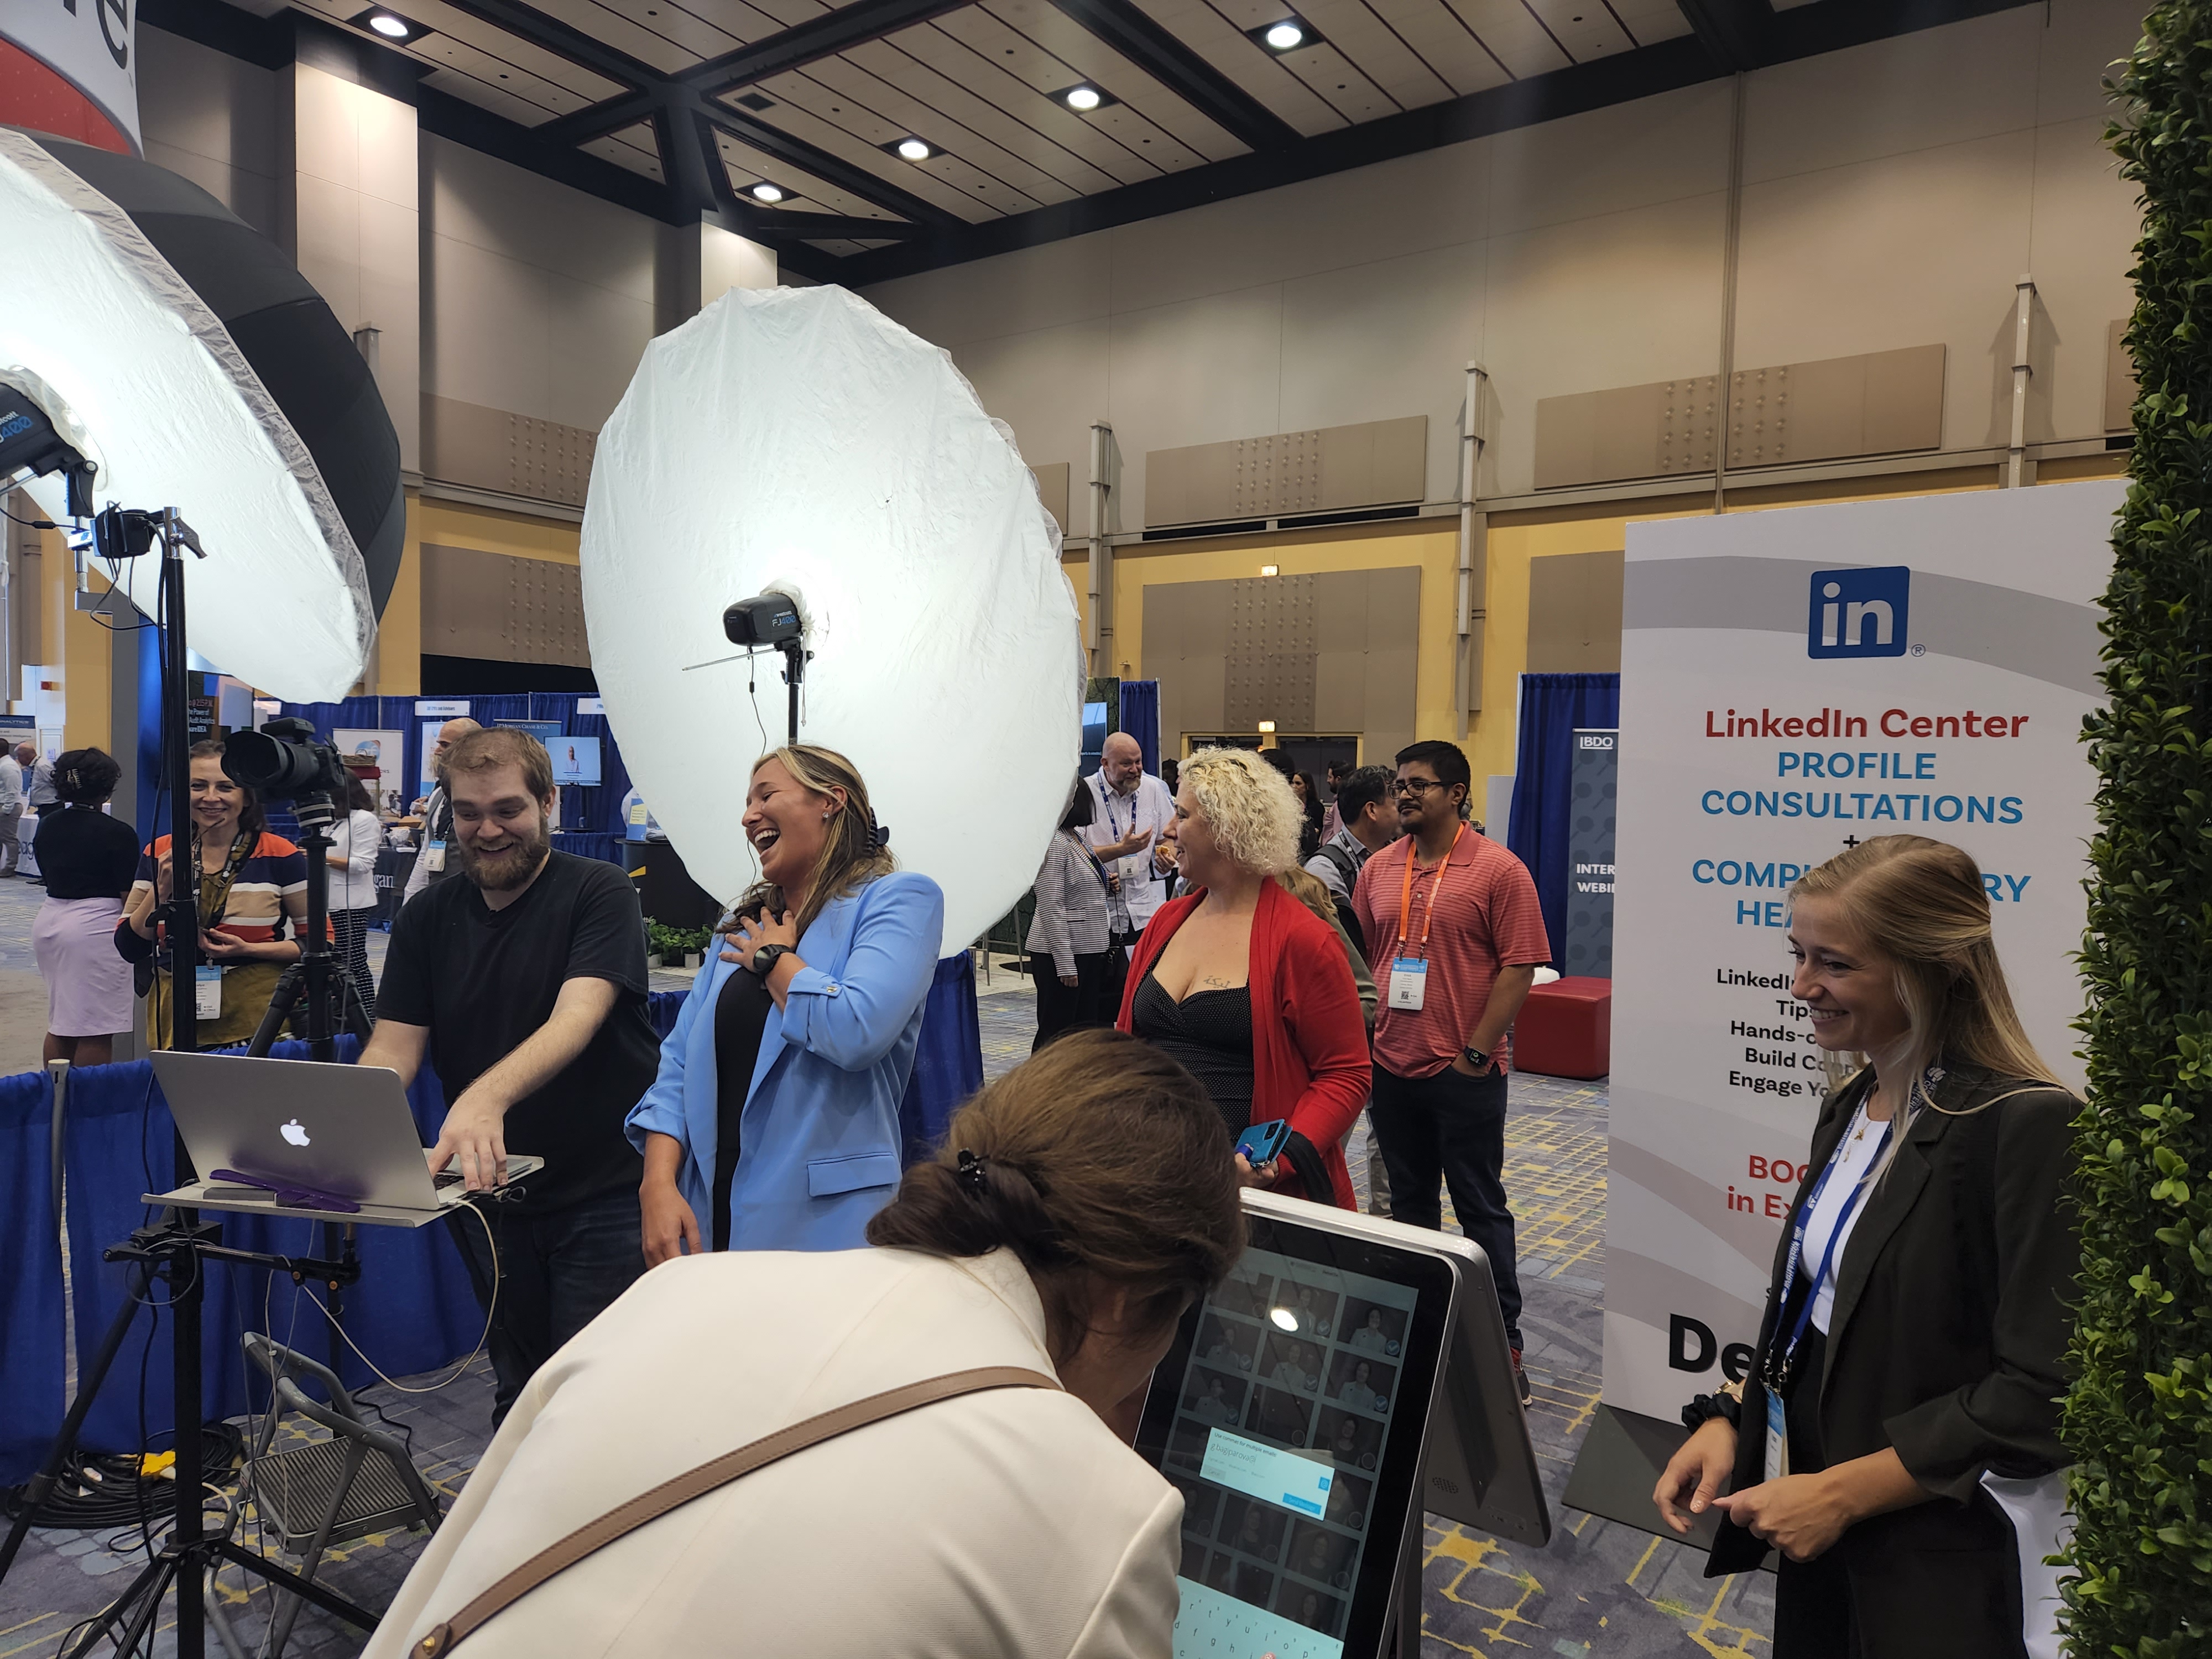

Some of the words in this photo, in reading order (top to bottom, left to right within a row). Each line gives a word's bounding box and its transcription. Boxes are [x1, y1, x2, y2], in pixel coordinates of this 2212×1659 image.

[771, 614, 796, 627] FJ400
[1705, 708, 1867, 738] LinkedIn
[1880, 708, 2029, 738] Center
[1778, 752, 1937, 780] PROFILE
[1702, 790, 2023, 825] CONSULTATIONS
[1737, 900, 1793, 928] HE
[1717, 968, 1794, 990] LinkedI
[1745, 1047, 1796, 1068] Build
[1729, 1070, 1802, 1097] Engage
[1728, 1185, 1754, 1214] in
[1223, 1437, 1239, 1446] commas
[1246, 1443, 1262, 1453] multiple
[1208, 1610, 1212, 1618] t
[1175, 1620, 1180, 1629] d
[1225, 1619, 1231, 1627] y
[1193, 1628, 1198, 1636] f
[1265, 1632, 1269, 1641] i
[1211, 1637, 1216, 1647] g
[1229, 1643, 1235, 1653] h
[1302, 1651, 1308, 1659] p
